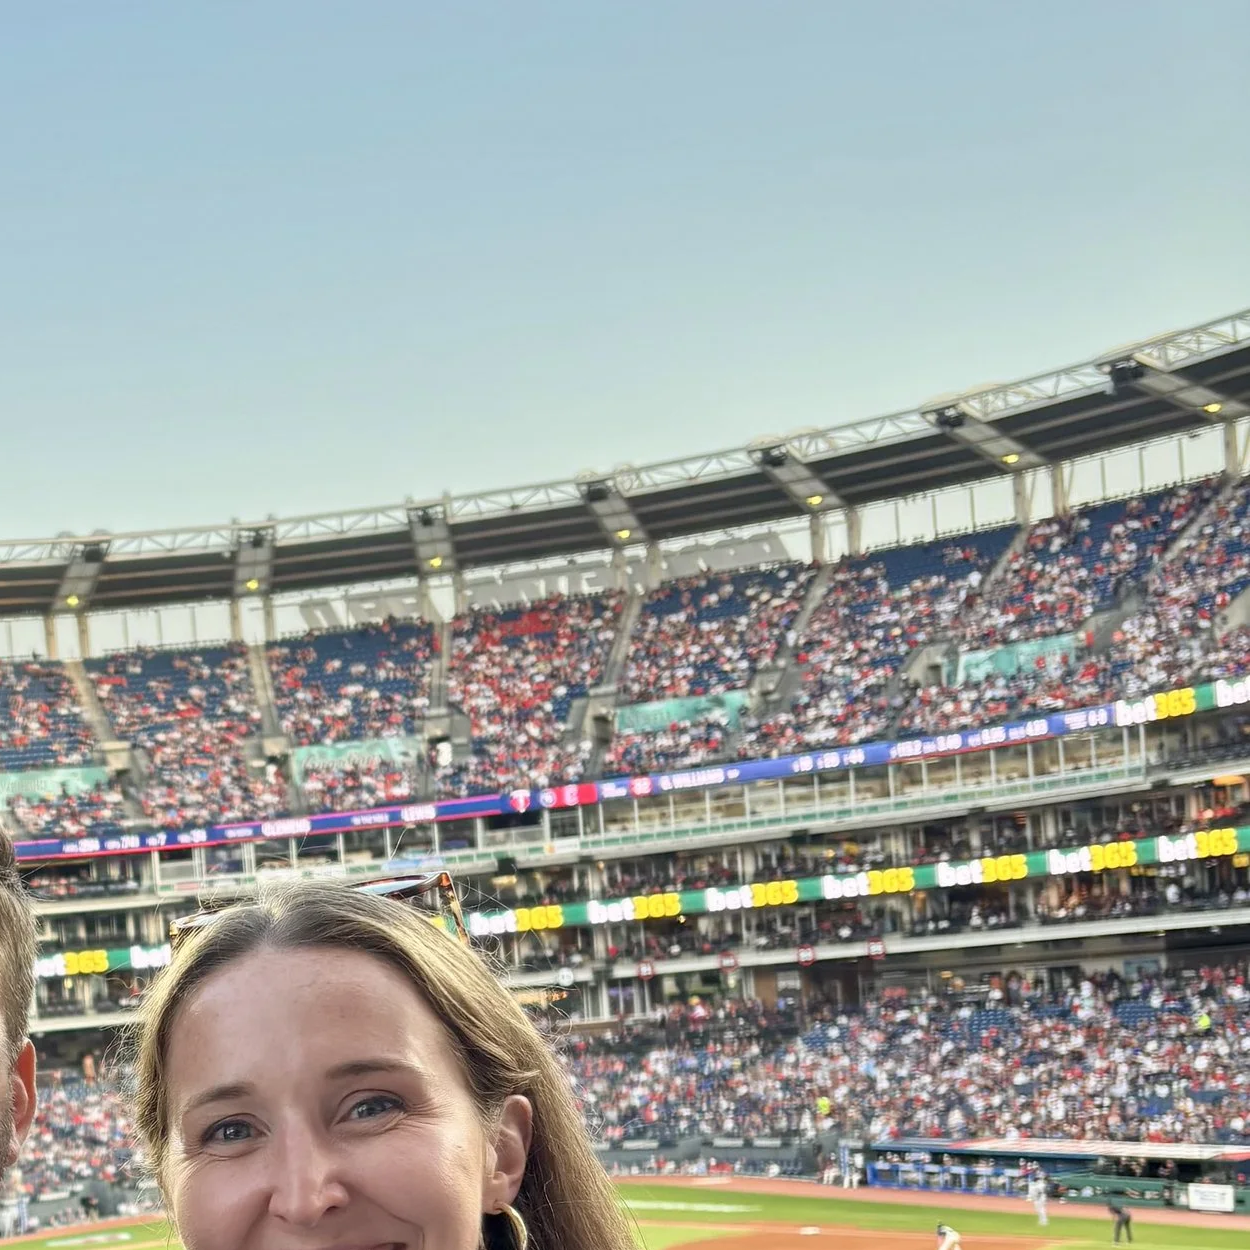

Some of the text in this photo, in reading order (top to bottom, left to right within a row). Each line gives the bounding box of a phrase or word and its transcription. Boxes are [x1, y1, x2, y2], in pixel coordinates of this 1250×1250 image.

[1116, 687, 1196, 727] bet365
[1050, 840, 1137, 875] bet365
[1158, 828, 1238, 862] bet365
[822, 867, 914, 899] bet365
[936, 854, 1028, 888] bet365
[587, 893, 681, 924] bet365
[705, 880, 798, 912] bet365
[469, 904, 564, 936] bet365
